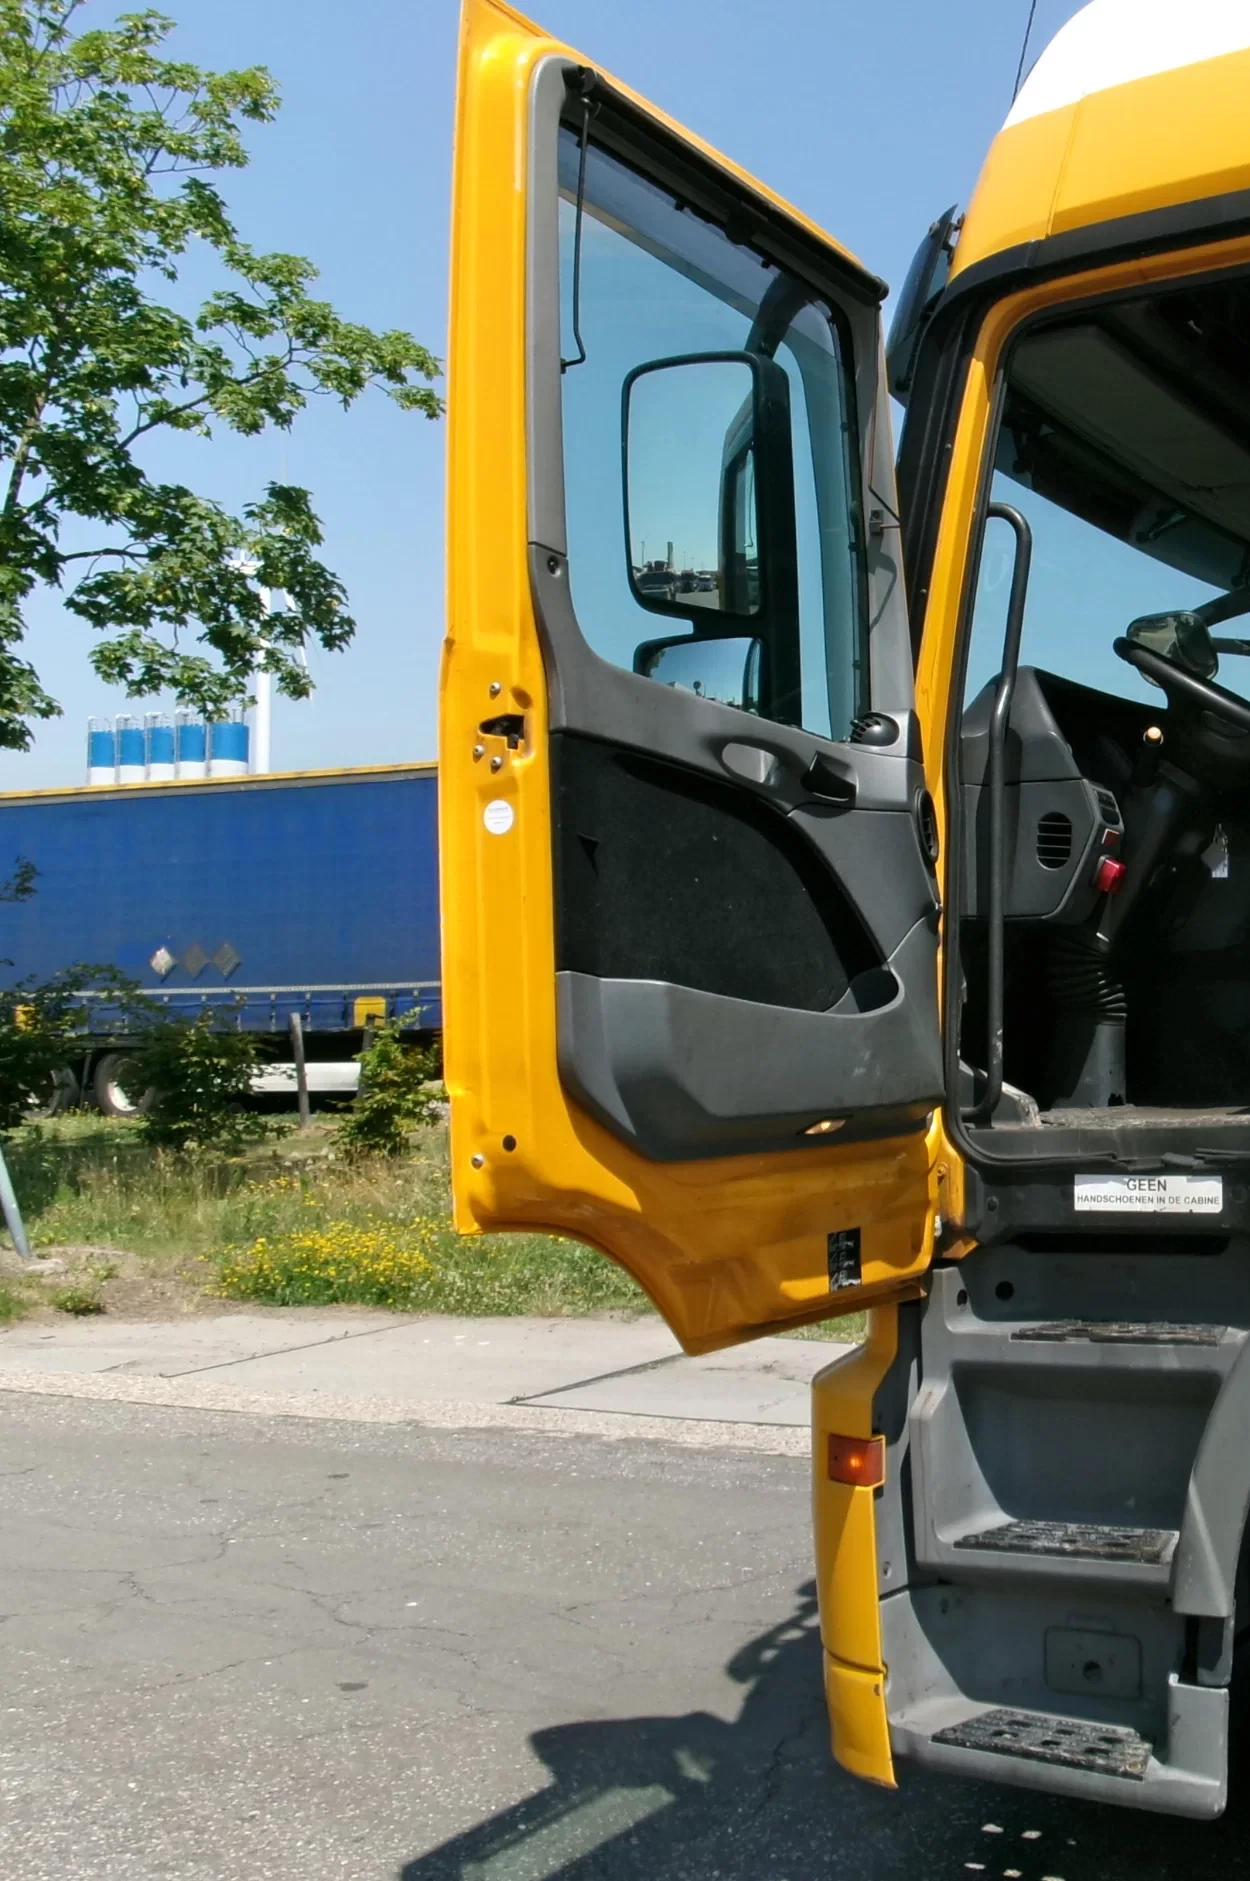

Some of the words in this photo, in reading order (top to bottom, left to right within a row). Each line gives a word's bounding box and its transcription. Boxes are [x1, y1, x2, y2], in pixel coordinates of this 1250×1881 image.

[1126, 1178, 1167, 1192] GEEN
[1077, 1195, 1154, 1204] HANDSCHOENEN
[1156, 1196, 1165, 1205] IN
[1168, 1196, 1181, 1205] DE
[1184, 1196, 1220, 1205] CABINE
